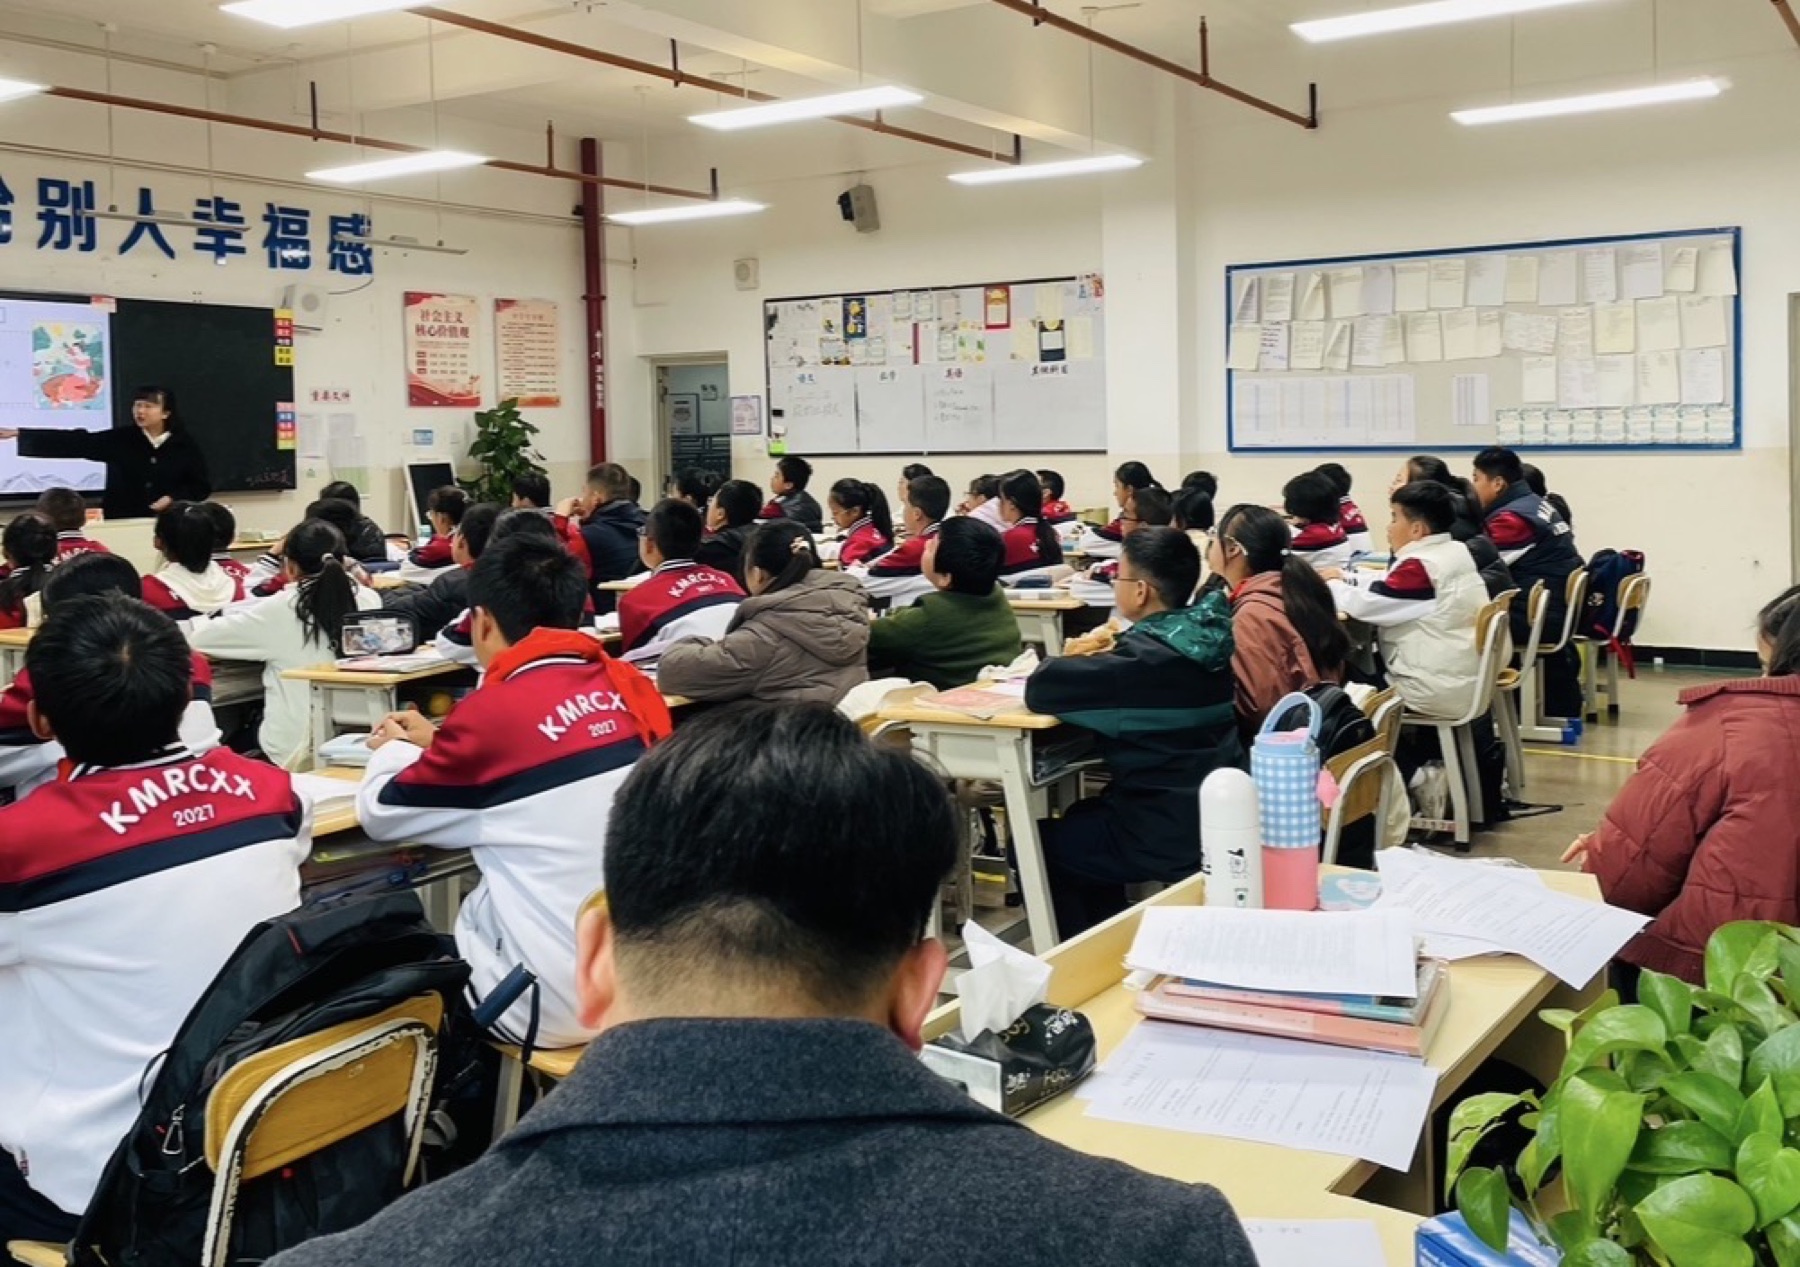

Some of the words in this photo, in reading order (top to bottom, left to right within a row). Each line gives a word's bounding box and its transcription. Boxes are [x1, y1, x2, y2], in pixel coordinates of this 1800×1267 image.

[0, 176, 373, 275] 别人幸福感
[420, 308, 463, 323] 社会主义
[415, 324, 470, 338] 核心价值观
[537, 691, 630, 742] KMRCX
[172, 803, 215, 827] 2027
